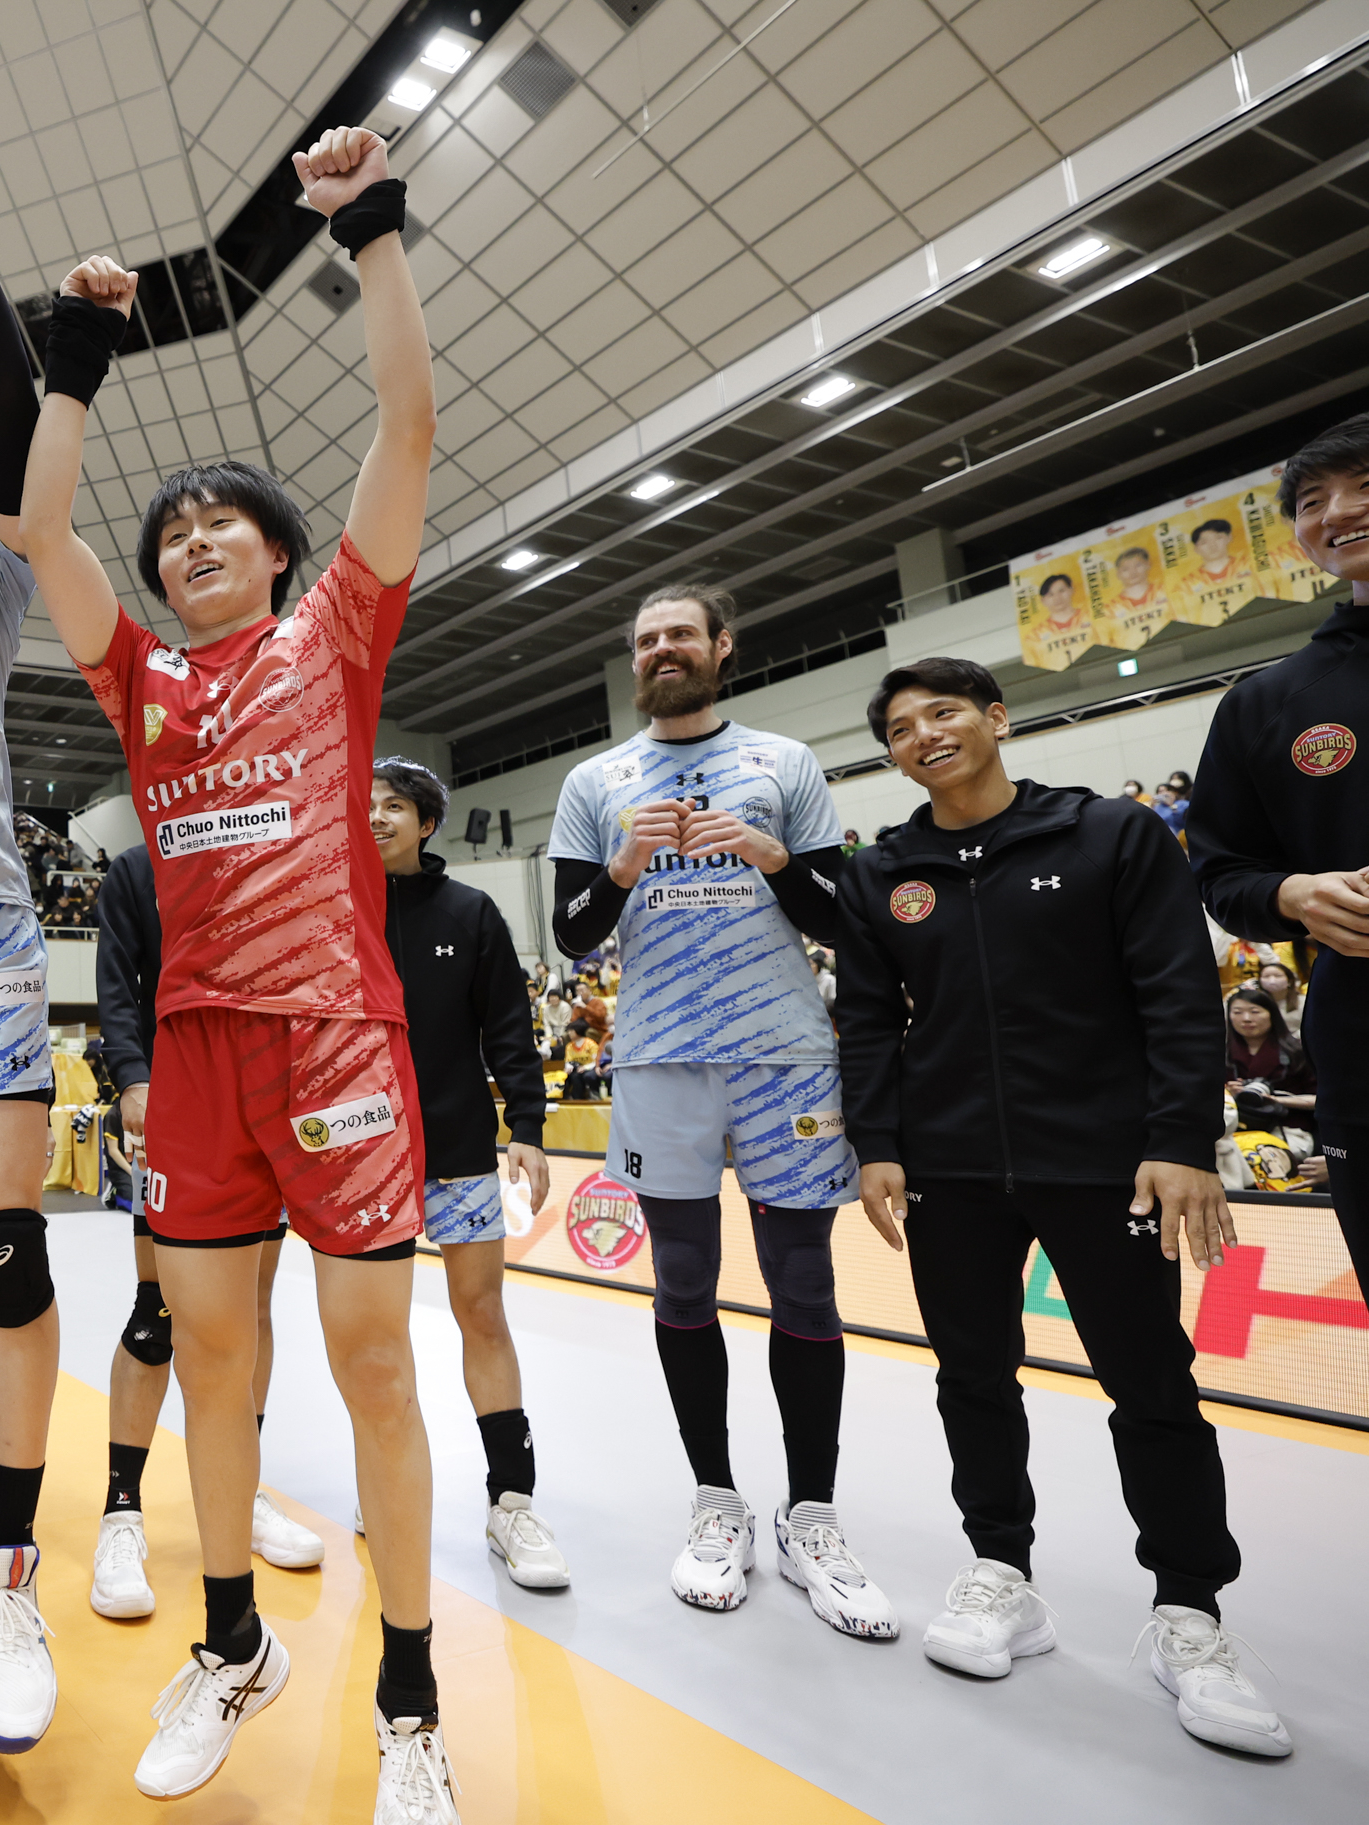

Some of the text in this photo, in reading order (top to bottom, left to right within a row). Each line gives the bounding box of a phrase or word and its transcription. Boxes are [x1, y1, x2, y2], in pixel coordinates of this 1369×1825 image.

[1295, 734, 1352, 763] SUNBIRDS
[177, 807, 286, 838] Chuo Nittochi
[179, 828, 269, 851] 中央日本土地建物グループ
[667, 886, 753, 899] Chuo Nittochi
[893, 890, 932, 911] SUNBIRDS
[0, 980, 42, 994] つの食品
[330, 1105, 391, 1132] つの食品
[624, 1148, 643, 1179] 18
[146, 1166, 168, 1213] 10
[570, 1195, 645, 1236] SUNBIRDS
